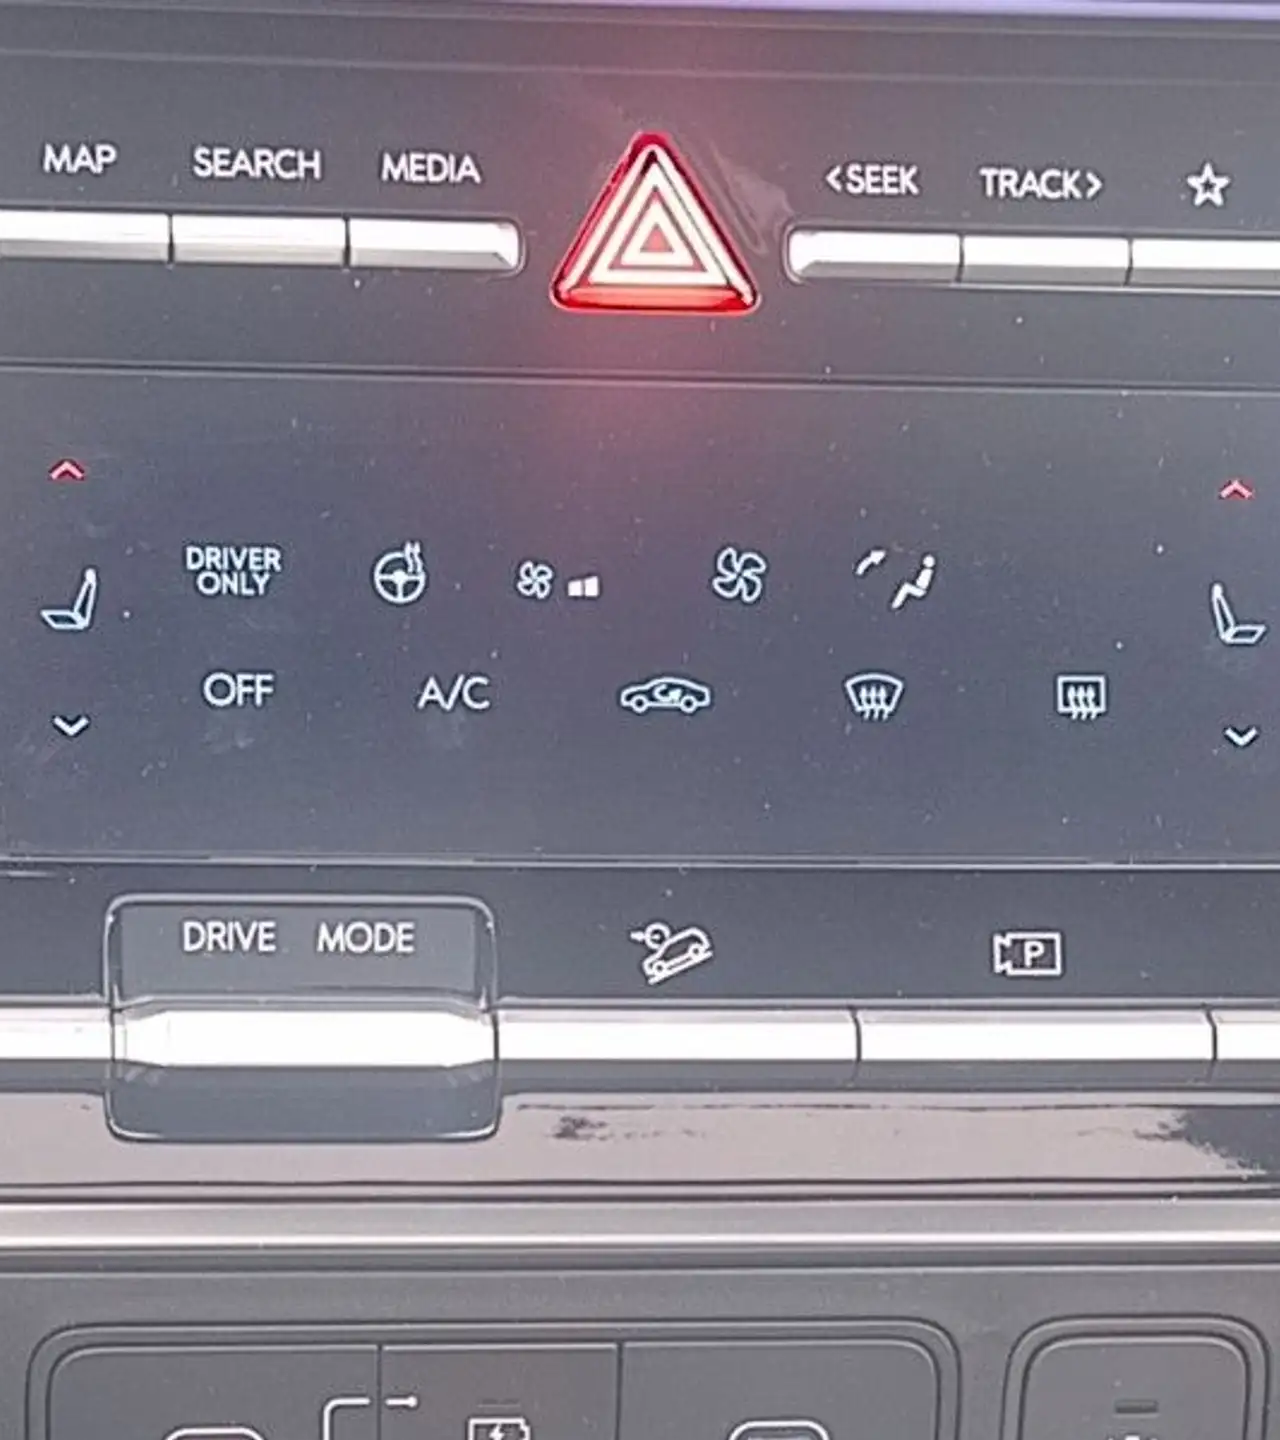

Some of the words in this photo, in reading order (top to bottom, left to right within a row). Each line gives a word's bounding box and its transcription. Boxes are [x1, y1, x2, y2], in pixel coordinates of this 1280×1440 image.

[43, 143, 117, 174] MAP
[192, 145, 322, 180] SEARCH
[380, 151, 482, 184] MEDIA
[185, 546, 282, 573] DRIVER
[196, 571, 272, 597] ONLY
[203, 671, 275, 708] OFF
[416, 675, 492, 712] A/C
[183, 920, 277, 953] DRIVE
[317, 921, 416, 954] MODE
